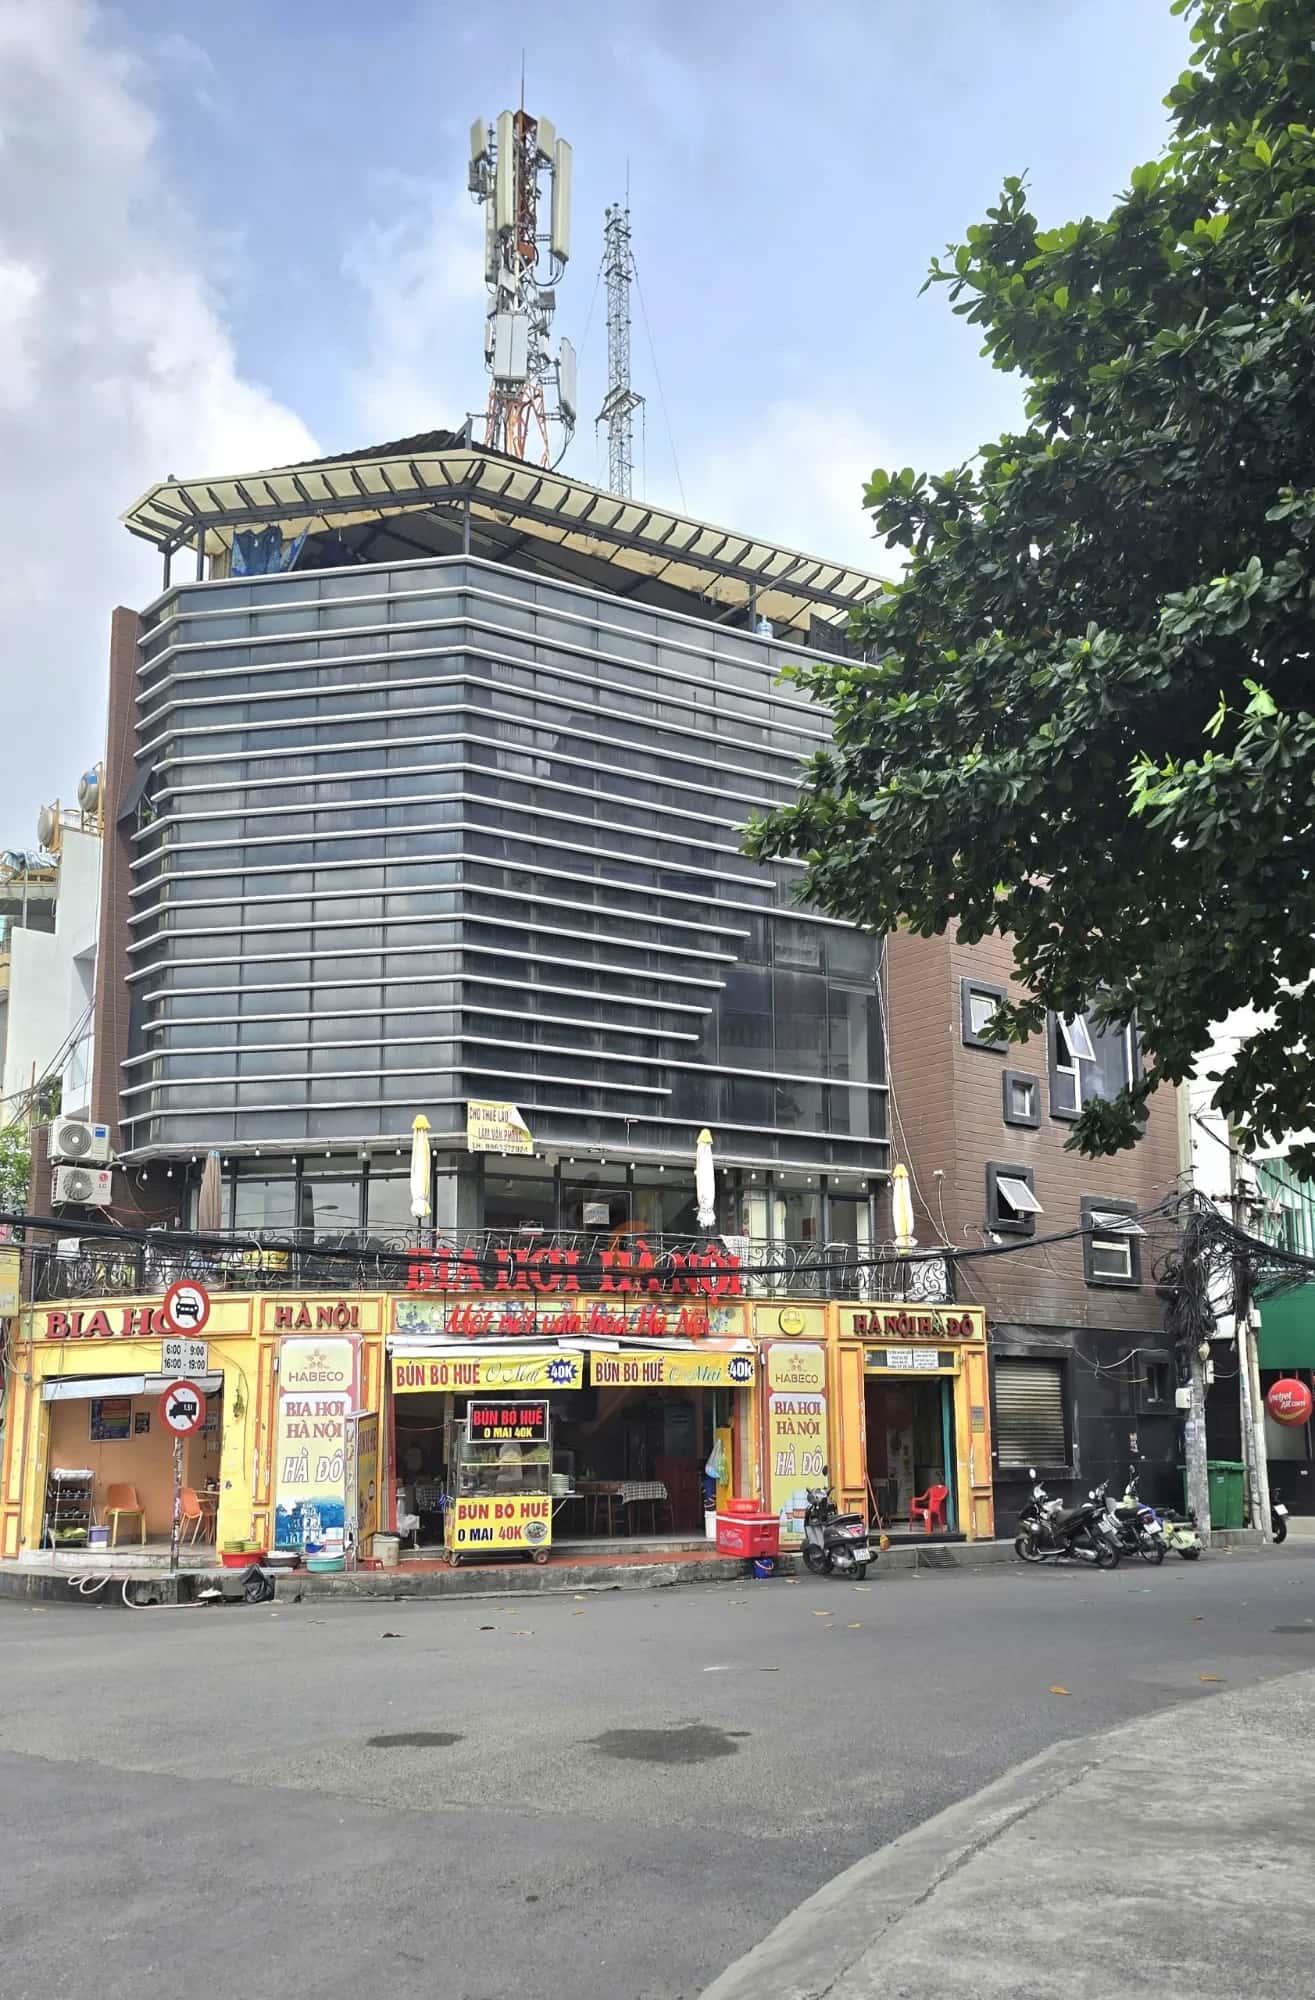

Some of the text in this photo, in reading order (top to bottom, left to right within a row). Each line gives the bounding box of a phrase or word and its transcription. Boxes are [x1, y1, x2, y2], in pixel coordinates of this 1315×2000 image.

[407, 1248, 485, 1290] BIA
[670, 1244, 743, 1305] NỘI
[275, 1298, 359, 1329] HÀ NỘI
[444, 1304, 493, 1339] Một
[636, 1304, 667, 1336] Hà
[853, 1310, 881, 1335] HÀ
[884, 1311, 916, 1338] NỘI
[947, 1313, 974, 1337] ĐÔ
[45, 1310, 113, 1339] BIA
[166, 1344, 181, 1354] 6:00
[190, 1345, 204, 1356] 9:00
[164, 1358, 181, 1369] 16:00
[188, 1359, 205, 1369] 19:00
[396, 1361, 425, 1387] BÚN
[430, 1360, 449, 1386] BÒ
[454, 1358, 481, 1385] HUẾ
[551, 1365, 573, 1379] 40K
[596, 1359, 620, 1382] BÚN
[624, 1358, 639, 1382] BÒ
[642, 1356, 665, 1382] HUẾ
[288, 1371, 344, 1382] HABECO
[775, 1373, 819, 1384] HABECO
[285, 1401, 345, 1417] BIA HƠI
[474, 1406, 543, 1426] BÚN BÒ HUẾ
[775, 1401, 821, 1416] BIA HƠI
[287, 1420, 312, 1439] HÀ
[314, 1420, 343, 1442] NỘI
[493, 1427, 512, 1438] MAI
[514, 1427, 533, 1438] 40K
[777, 1417, 820, 1438] HÀ NỘI
[282, 1447, 309, 1483] HÀ
[315, 1449, 344, 1483] ĐÔ
[775, 1443, 824, 1476] HÀ ĐÔ
[458, 1499, 550, 1520] BÚN BÒ HUẾ
[469, 1528, 493, 1541] MAI
[499, 1526, 522, 1540] 40K
